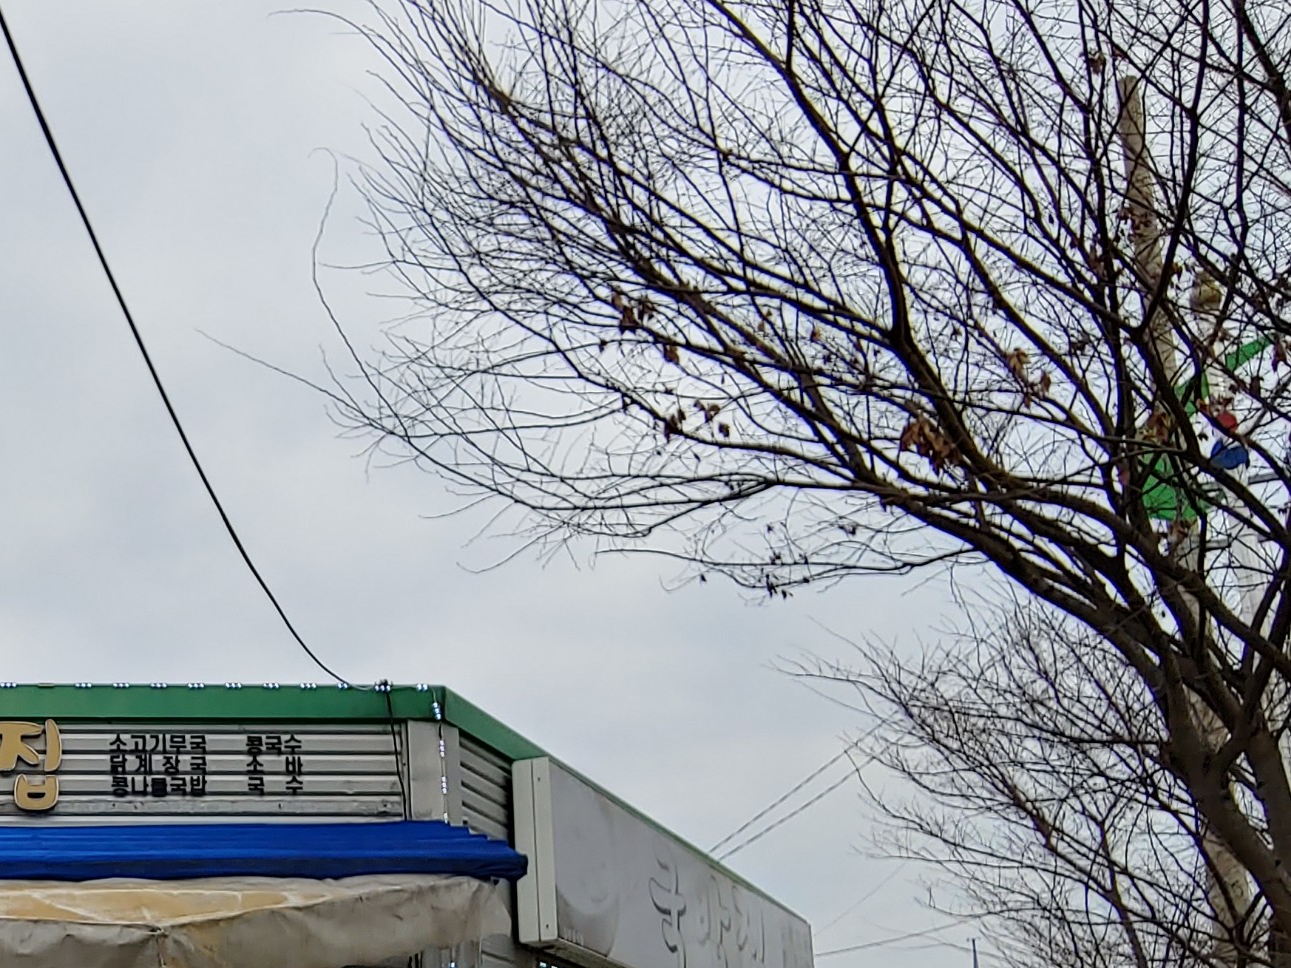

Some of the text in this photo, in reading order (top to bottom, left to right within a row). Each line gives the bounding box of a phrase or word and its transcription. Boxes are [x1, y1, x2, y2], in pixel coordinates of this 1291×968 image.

[109, 733, 302, 757] 소고기무국 콩국수
[111, 776, 303, 797] 콩나물국밥 국수
